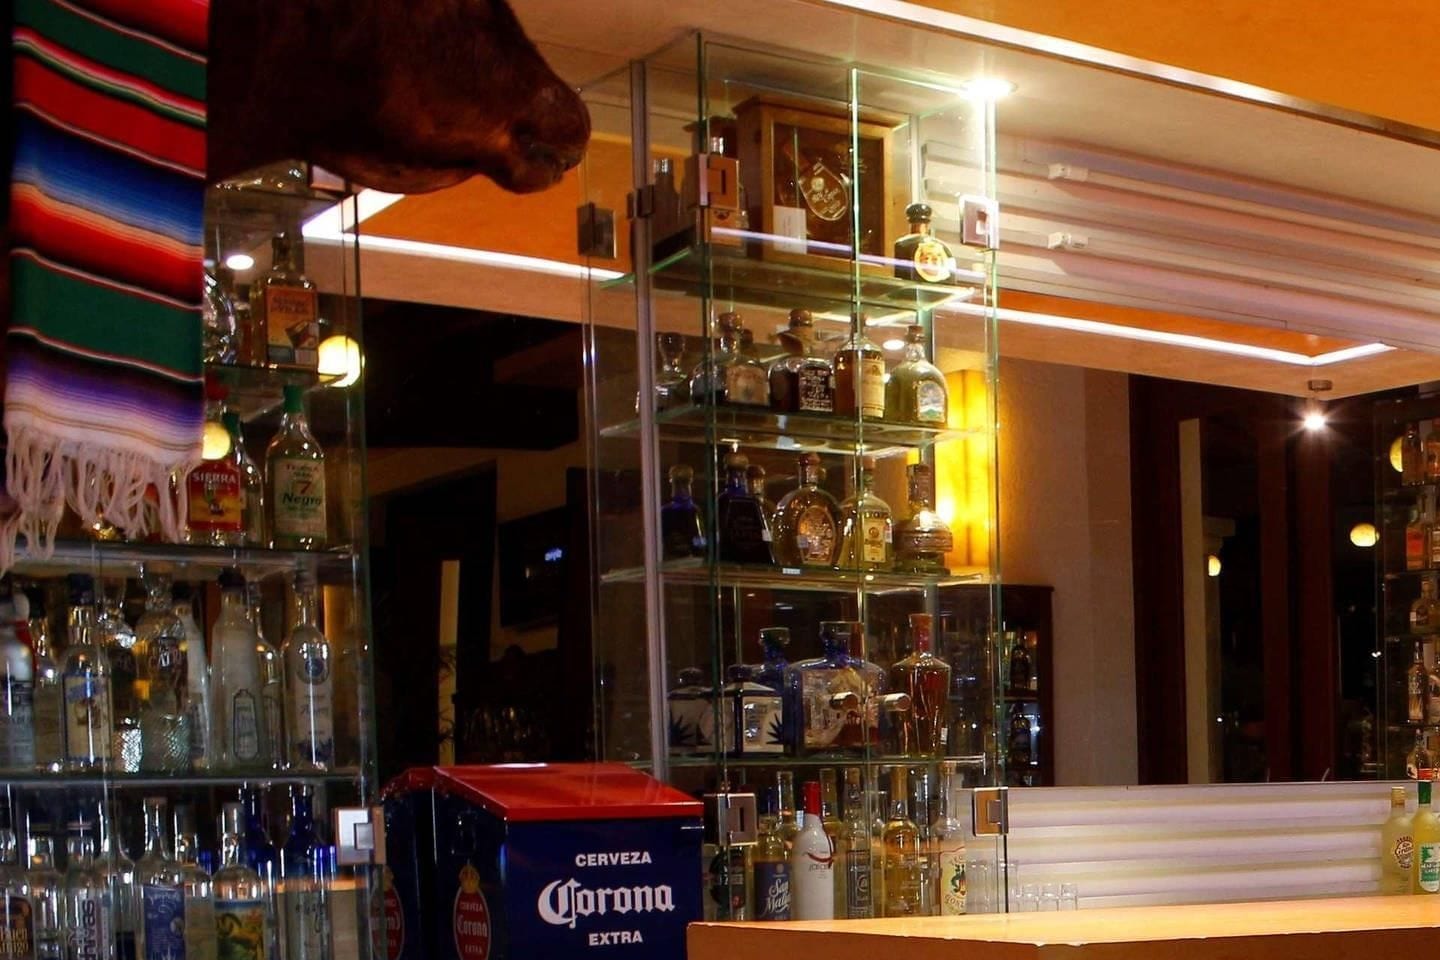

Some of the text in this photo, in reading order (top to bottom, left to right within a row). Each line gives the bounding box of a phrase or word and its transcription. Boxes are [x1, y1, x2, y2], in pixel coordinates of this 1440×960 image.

[191, 472, 237, 484] SIERRA
[575, 851, 652, 868] CERVEZA
[537, 877, 676, 929] Corona
[456, 914, 488, 938] Corona
[588, 930, 643, 947] EXTRA
